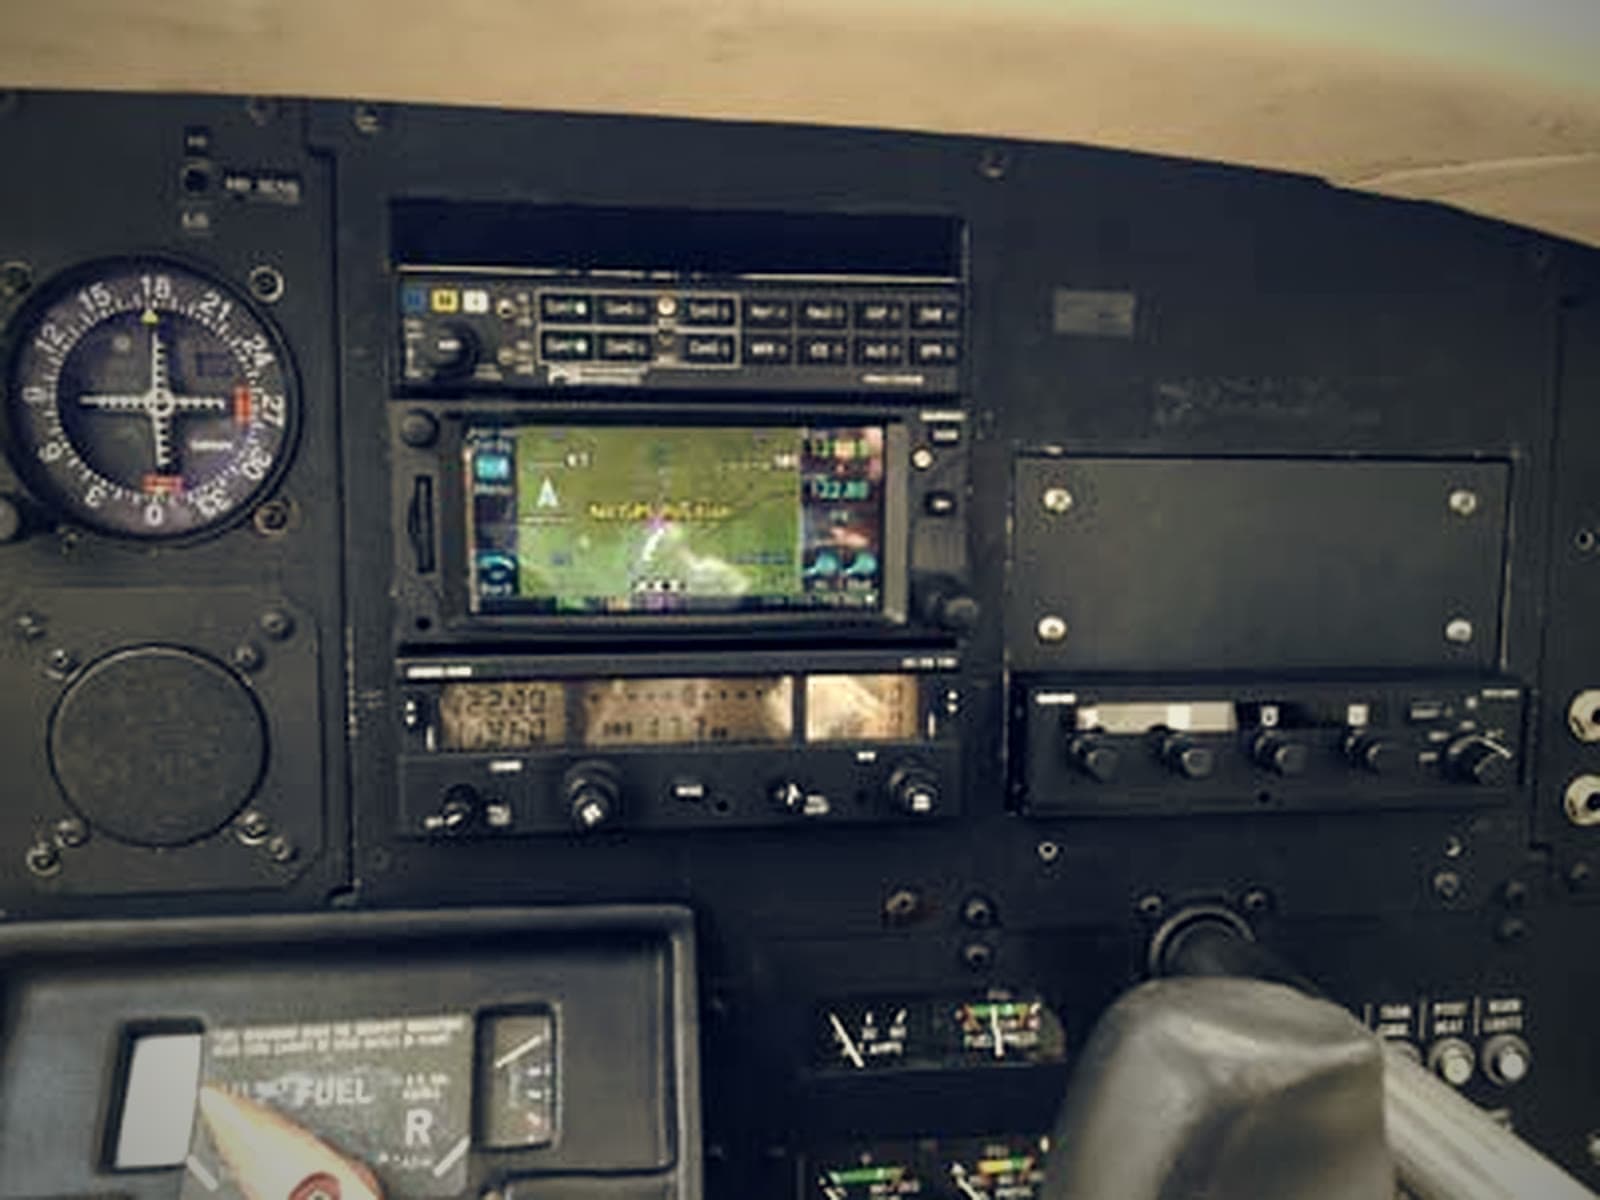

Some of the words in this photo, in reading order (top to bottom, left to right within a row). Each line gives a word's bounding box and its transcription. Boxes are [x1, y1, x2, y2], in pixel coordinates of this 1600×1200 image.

[78, 281, 111, 312] 15
[140, 275, 171, 298] 18
[199, 291, 233, 321] 21
[34, 323, 66, 353] 12
[242, 335, 276, 367] 24
[262, 394, 285, 428] 27
[240, 448, 273, 480] 30
[84, 486, 108, 508] 3
[144, 504, 163, 526] 0
[294, 1074, 374, 1107] FUEL
[405, 1108, 434, 1146] R
